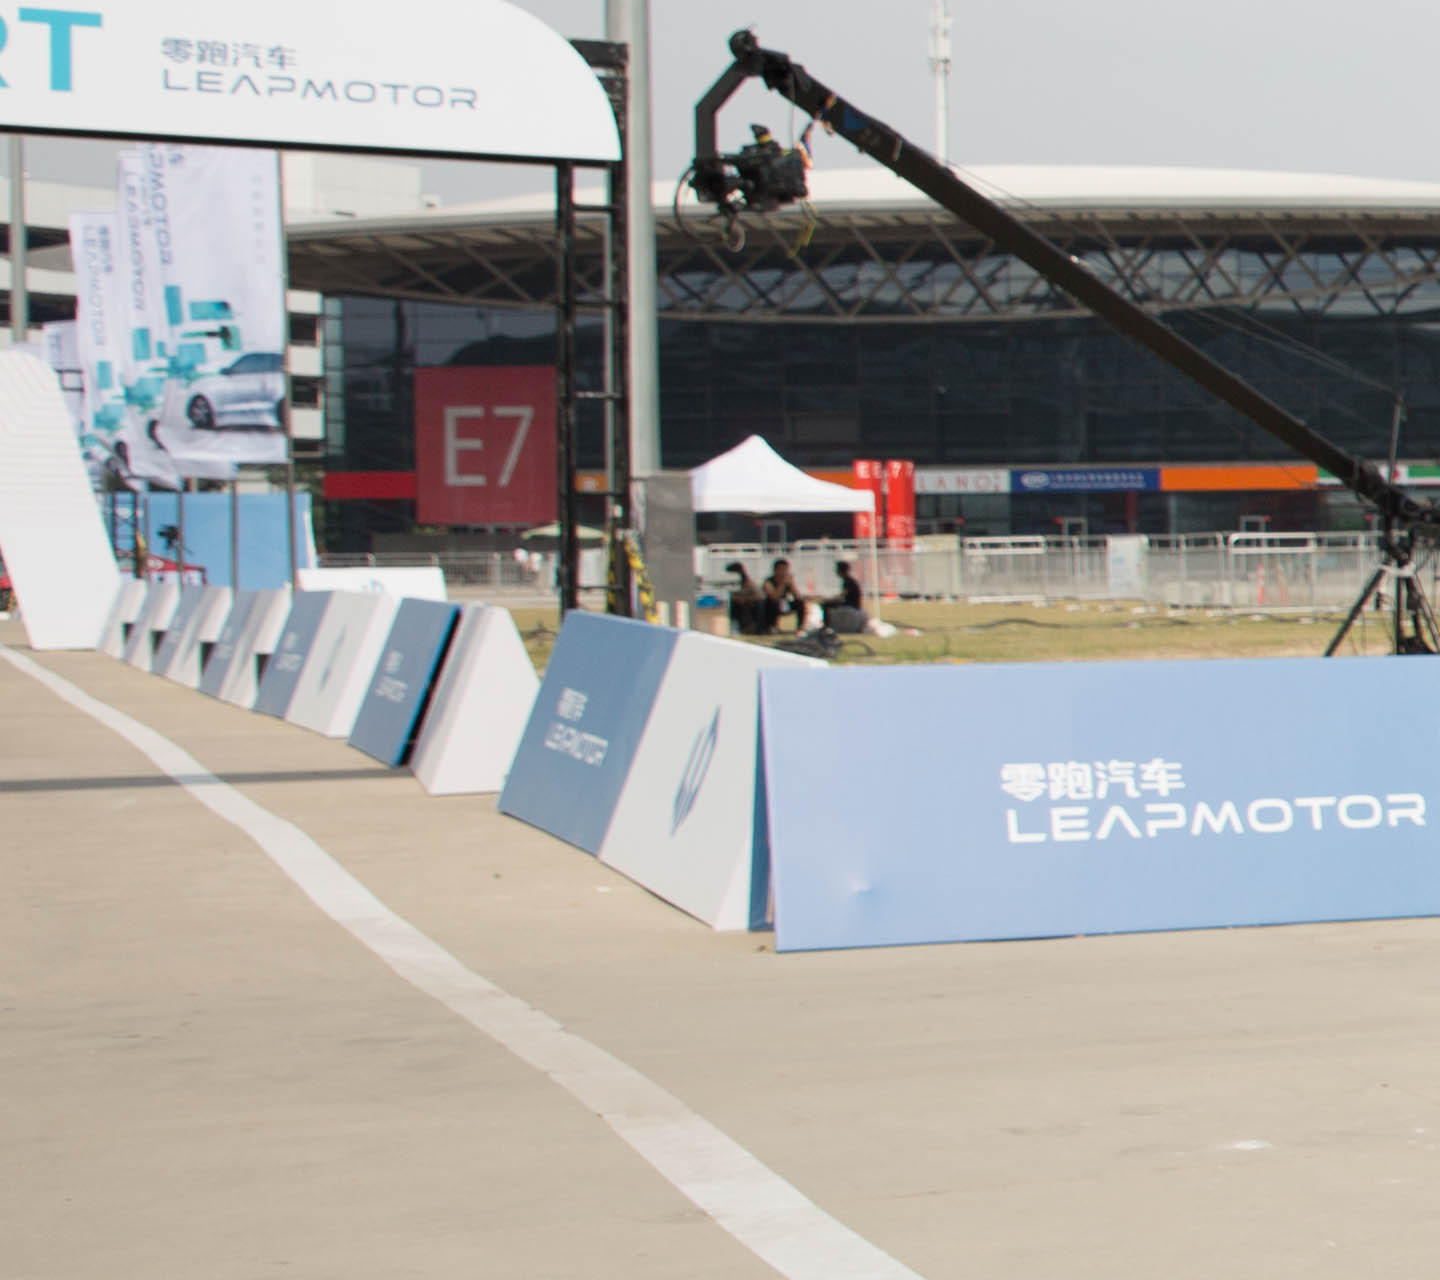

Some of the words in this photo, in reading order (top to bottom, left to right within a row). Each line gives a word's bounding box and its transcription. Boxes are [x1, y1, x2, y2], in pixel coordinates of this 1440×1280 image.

[0, 6, 103, 92] T
[160, 37, 299, 71] 零跑汽车
[163, 67, 479, 111] LEAPMOTOR
[443, 405, 535, 488] E7
[1000, 757, 1186, 803] 零跑汽车
[1006, 792, 1427, 845] LEAPMOTOR
